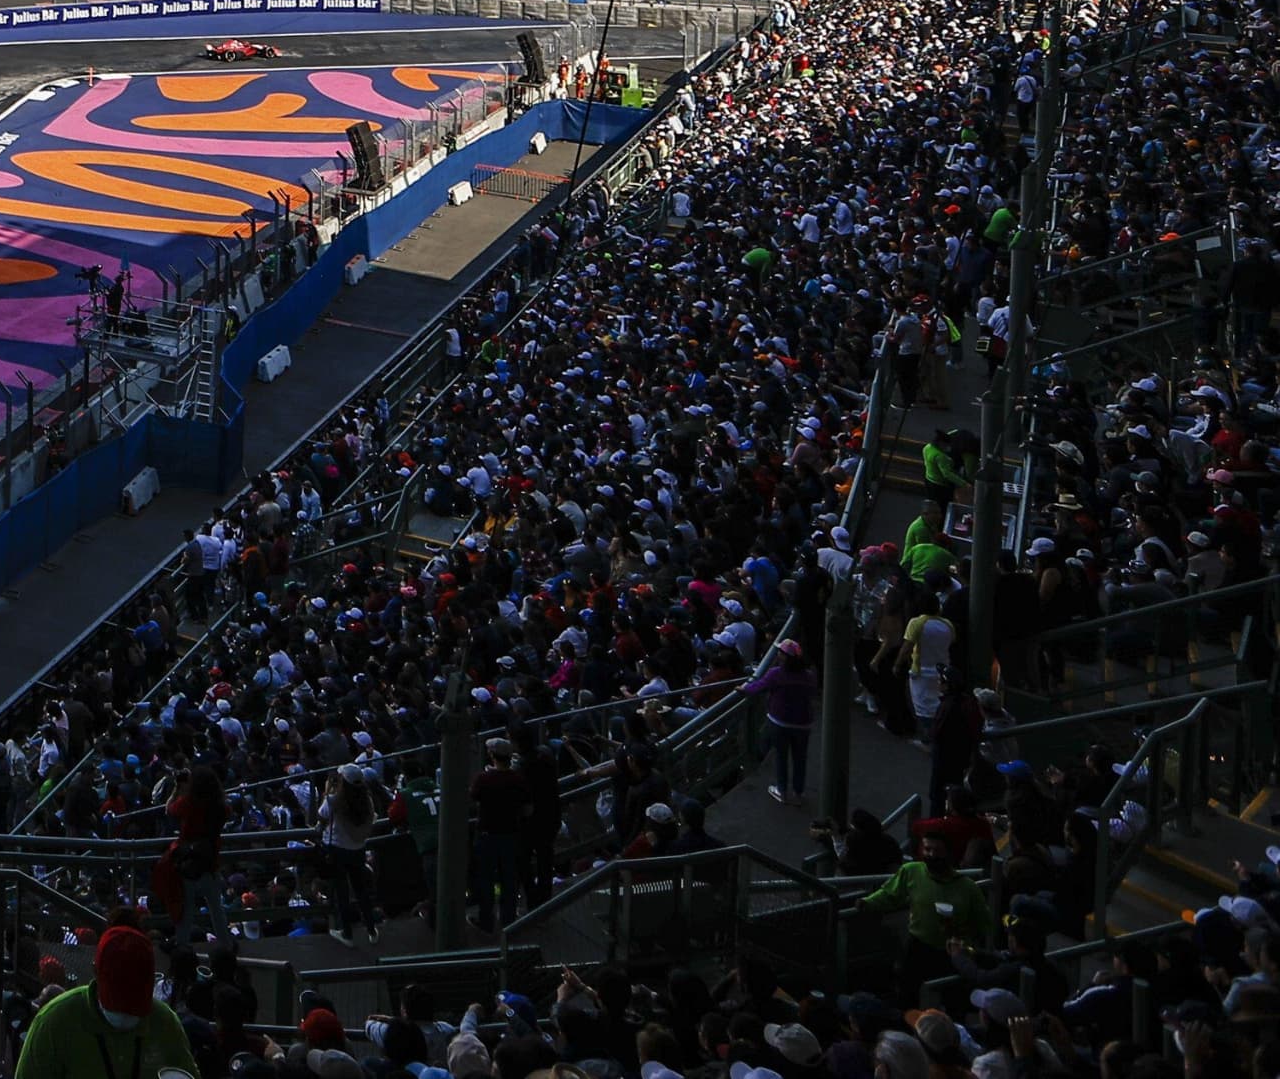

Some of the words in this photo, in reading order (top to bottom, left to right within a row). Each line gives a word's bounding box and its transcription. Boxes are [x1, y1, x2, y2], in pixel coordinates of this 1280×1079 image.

[113, 5, 140, 17] Julius
[141, 3, 159, 14] Bär
[162, 2, 191, 14] Julius
[191, 1, 209, 10] Bär
[213, 0, 241, 11] Julius
[12, 11, 42, 25] Julius
[42, 10, 59, 20] Bär
[62, 7, 90, 20] Julius
[90, 7, 109, 17] Bär
